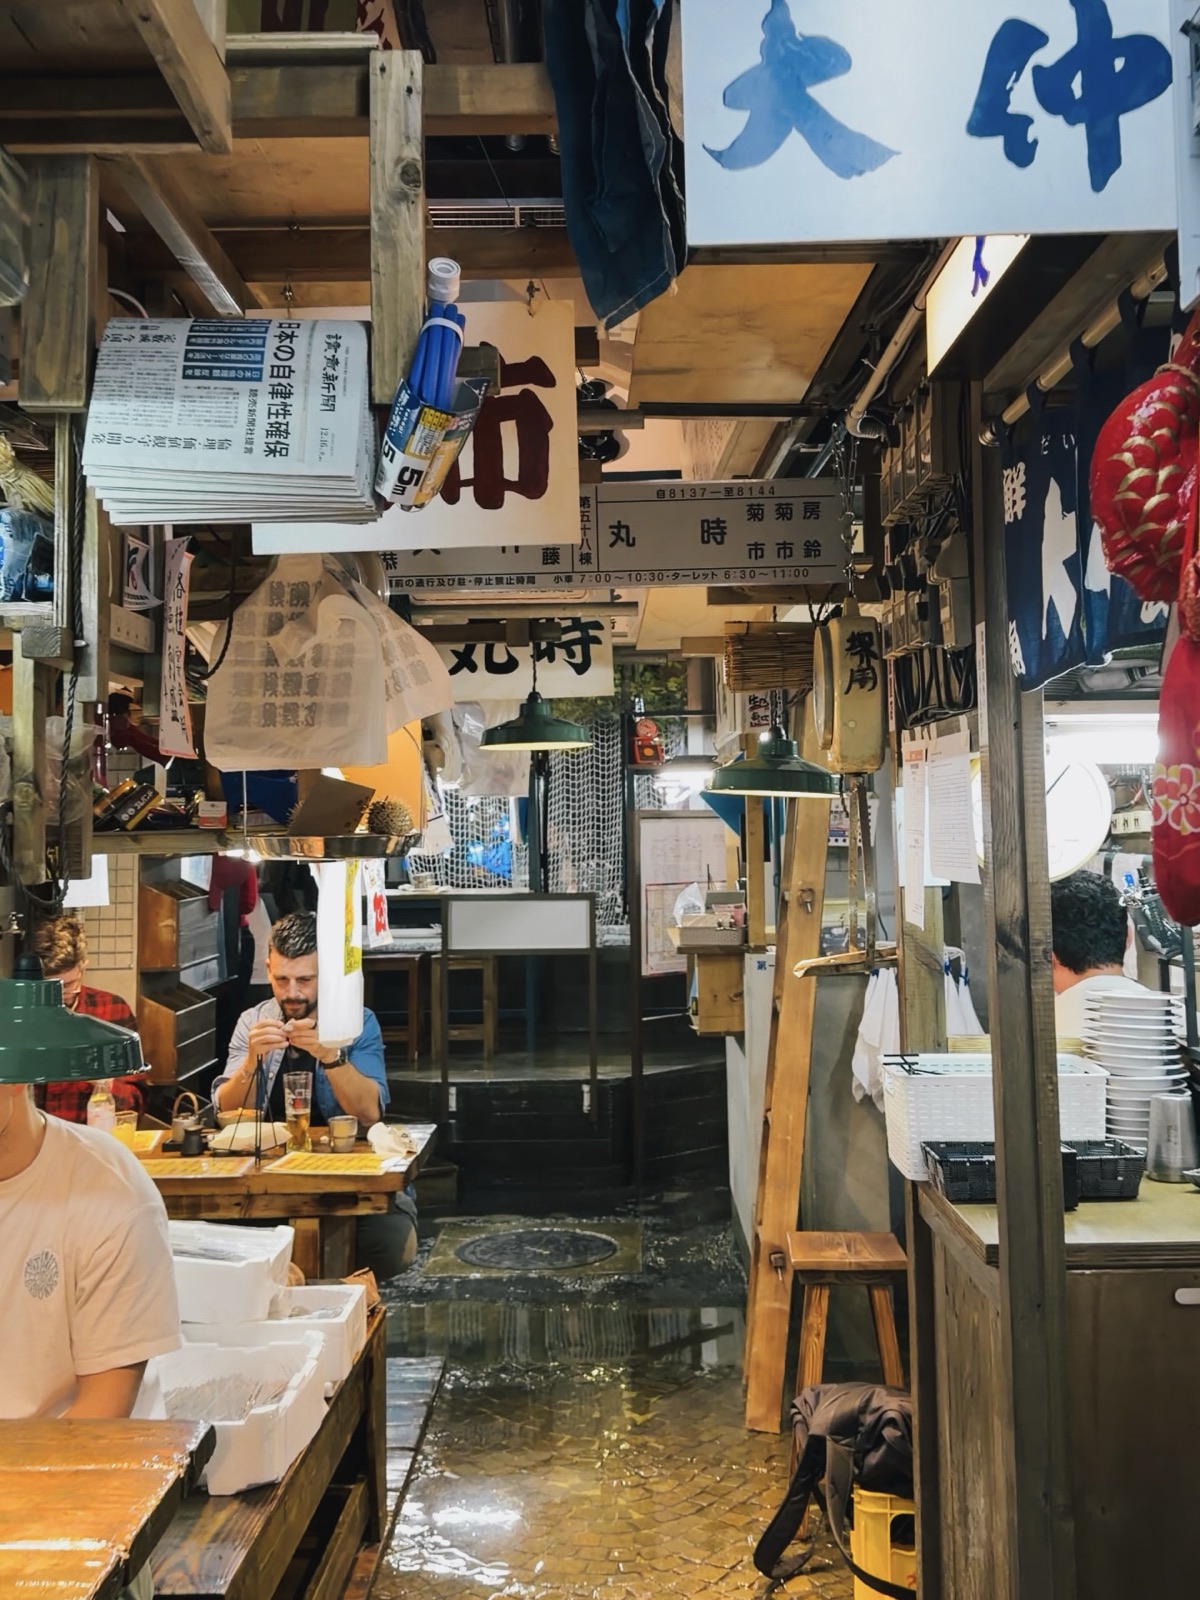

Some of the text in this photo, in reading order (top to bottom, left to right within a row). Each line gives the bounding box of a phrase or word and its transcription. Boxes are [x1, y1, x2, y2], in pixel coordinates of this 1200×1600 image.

[263, 322, 302, 458] 日本の自律性確保
[91, 432, 232, 451] 倫理・価値観守り開発
[243, 388, 259, 455] 読売新聞社提言
[391, 465, 425, 496] 5m
[578, 495, 593, 566] 第五十八棟
[608, 517, 728, 549] 丸時
